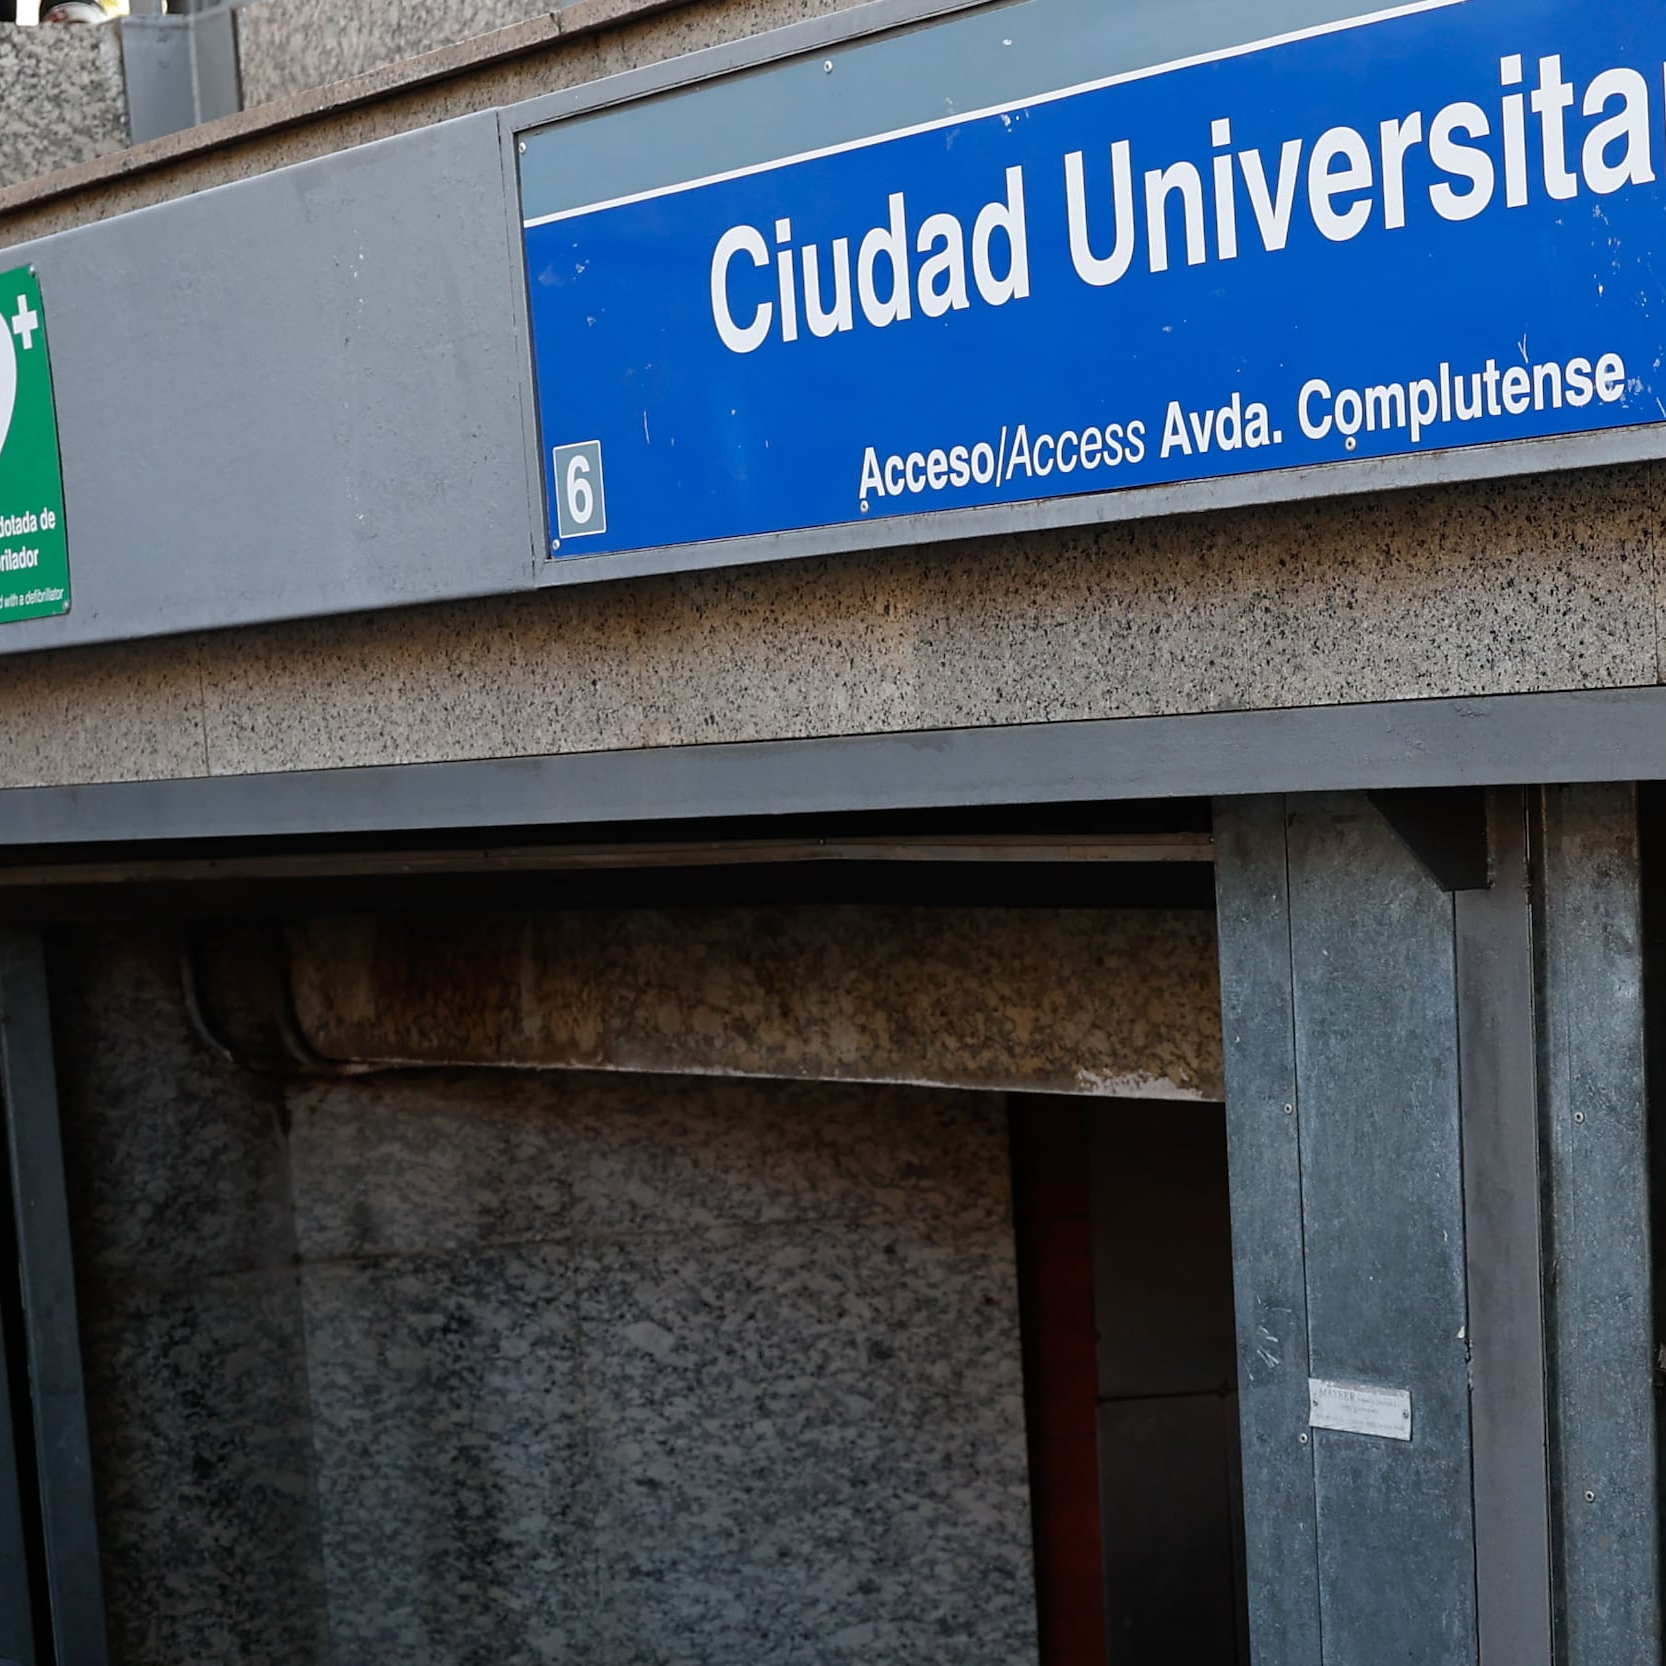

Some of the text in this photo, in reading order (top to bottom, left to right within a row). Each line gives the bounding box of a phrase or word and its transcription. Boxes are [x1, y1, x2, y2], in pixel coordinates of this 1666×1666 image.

[710, 165, 1030, 354] Ciudad
[859, 352, 1626, 499] Acceso/Access Avda. Complutense
[39, 506, 56, 531] de
[565, 453, 595, 526] 6
[4, 592, 19, 608] with
[25, 587, 64, 605] defibrillator
